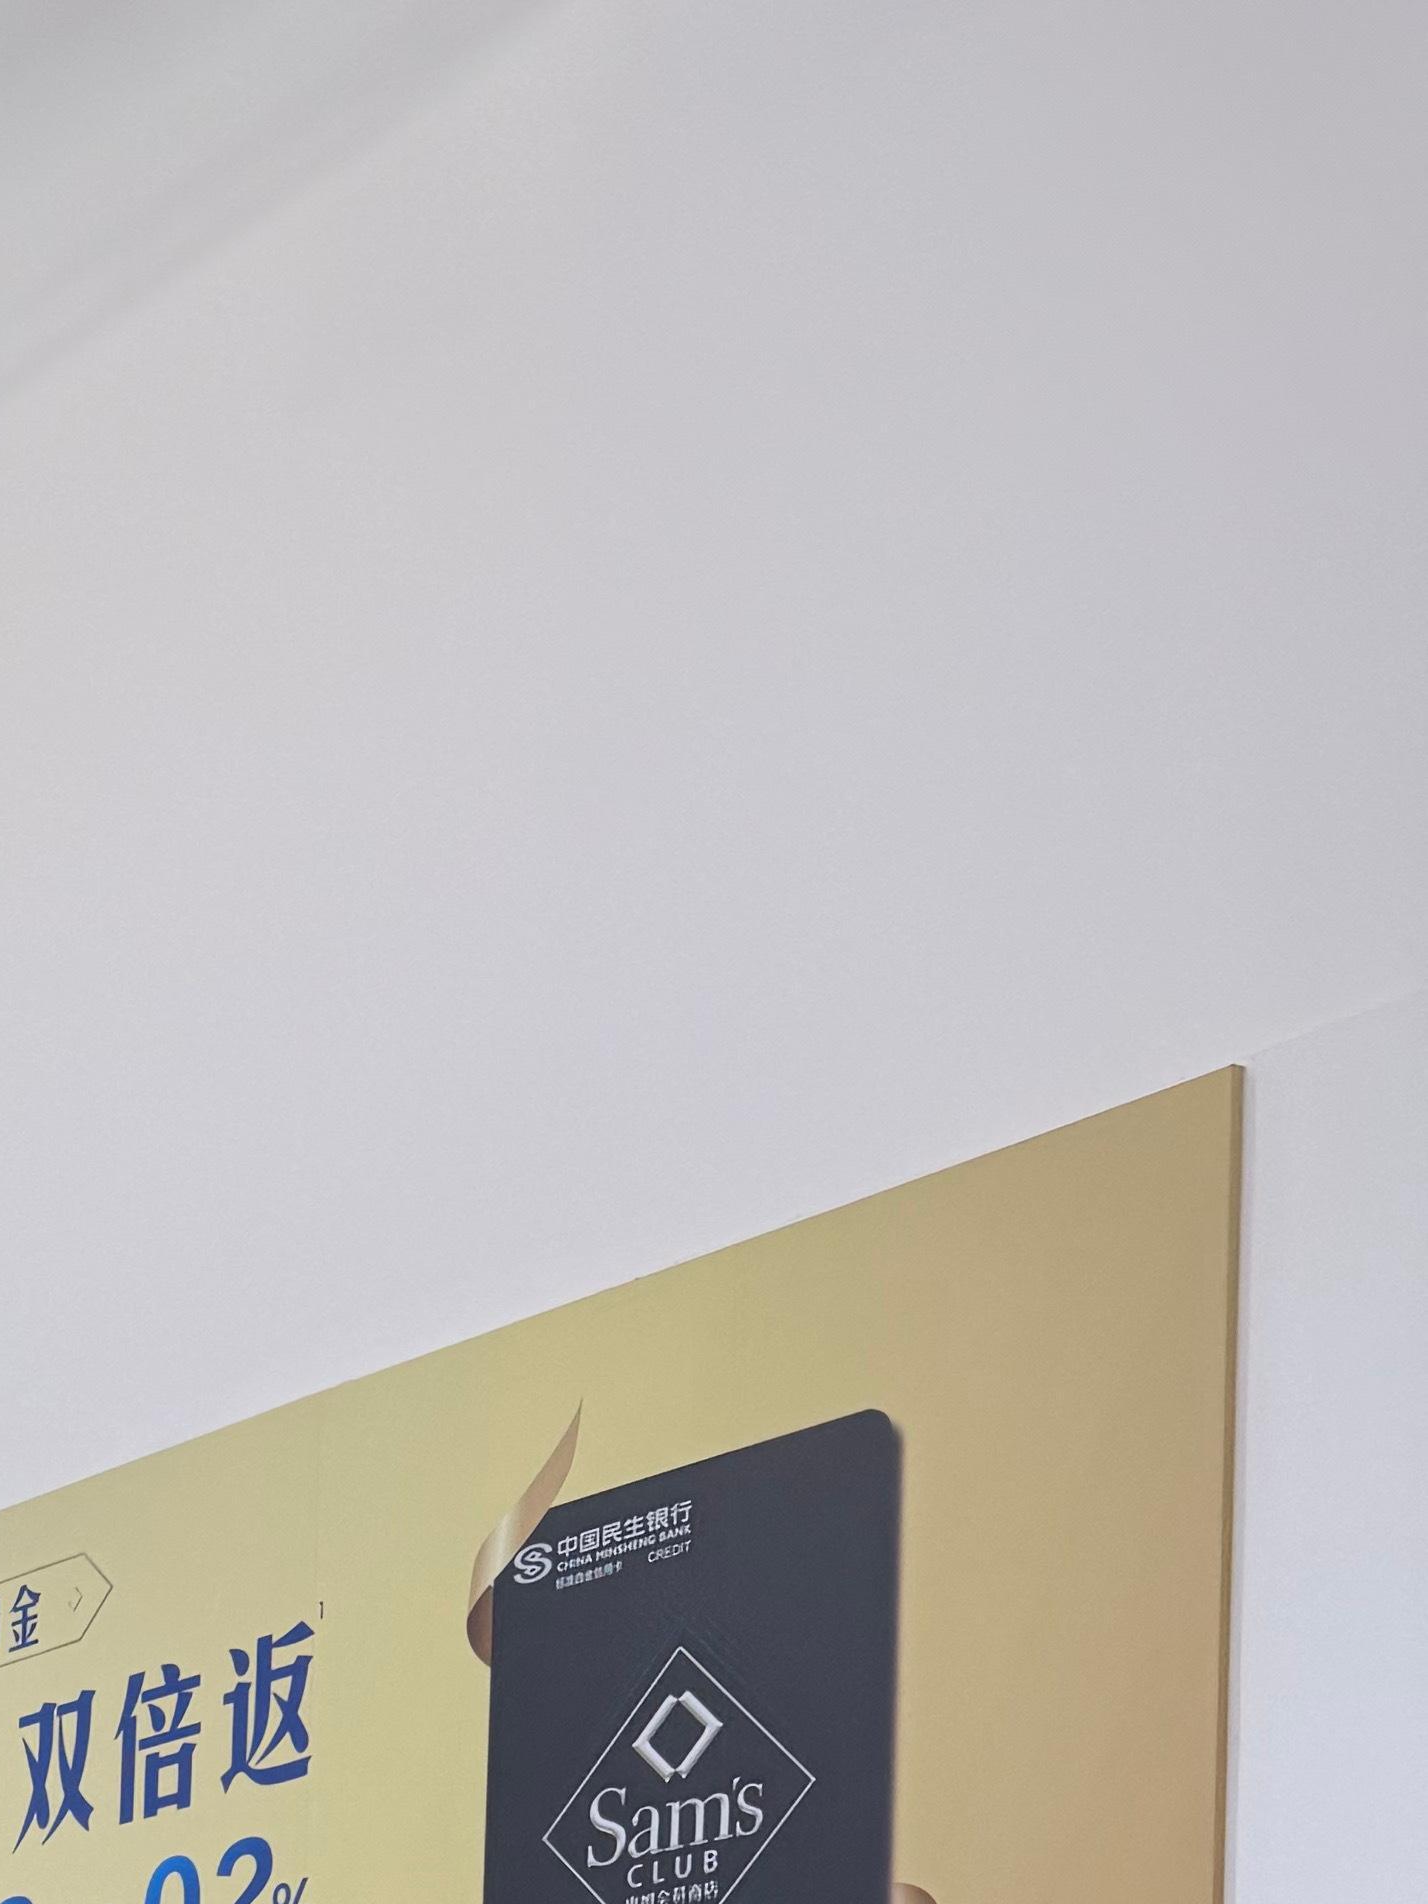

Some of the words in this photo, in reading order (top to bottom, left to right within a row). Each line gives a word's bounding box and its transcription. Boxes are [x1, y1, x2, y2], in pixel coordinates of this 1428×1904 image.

[556, 1554, 594, 1573] CHINA
[595, 1535, 657, 1564] MINSHENG
[658, 1524, 692, 1543] BANK
[557, 1500, 693, 1557] 中国民生银行
[647, 1539, 693, 1564] CREDIT
[12, 1620, 316, 1855] 双倍返
[586, 1776, 765, 1868] Sam's
[627, 1849, 718, 1889] CLUB
